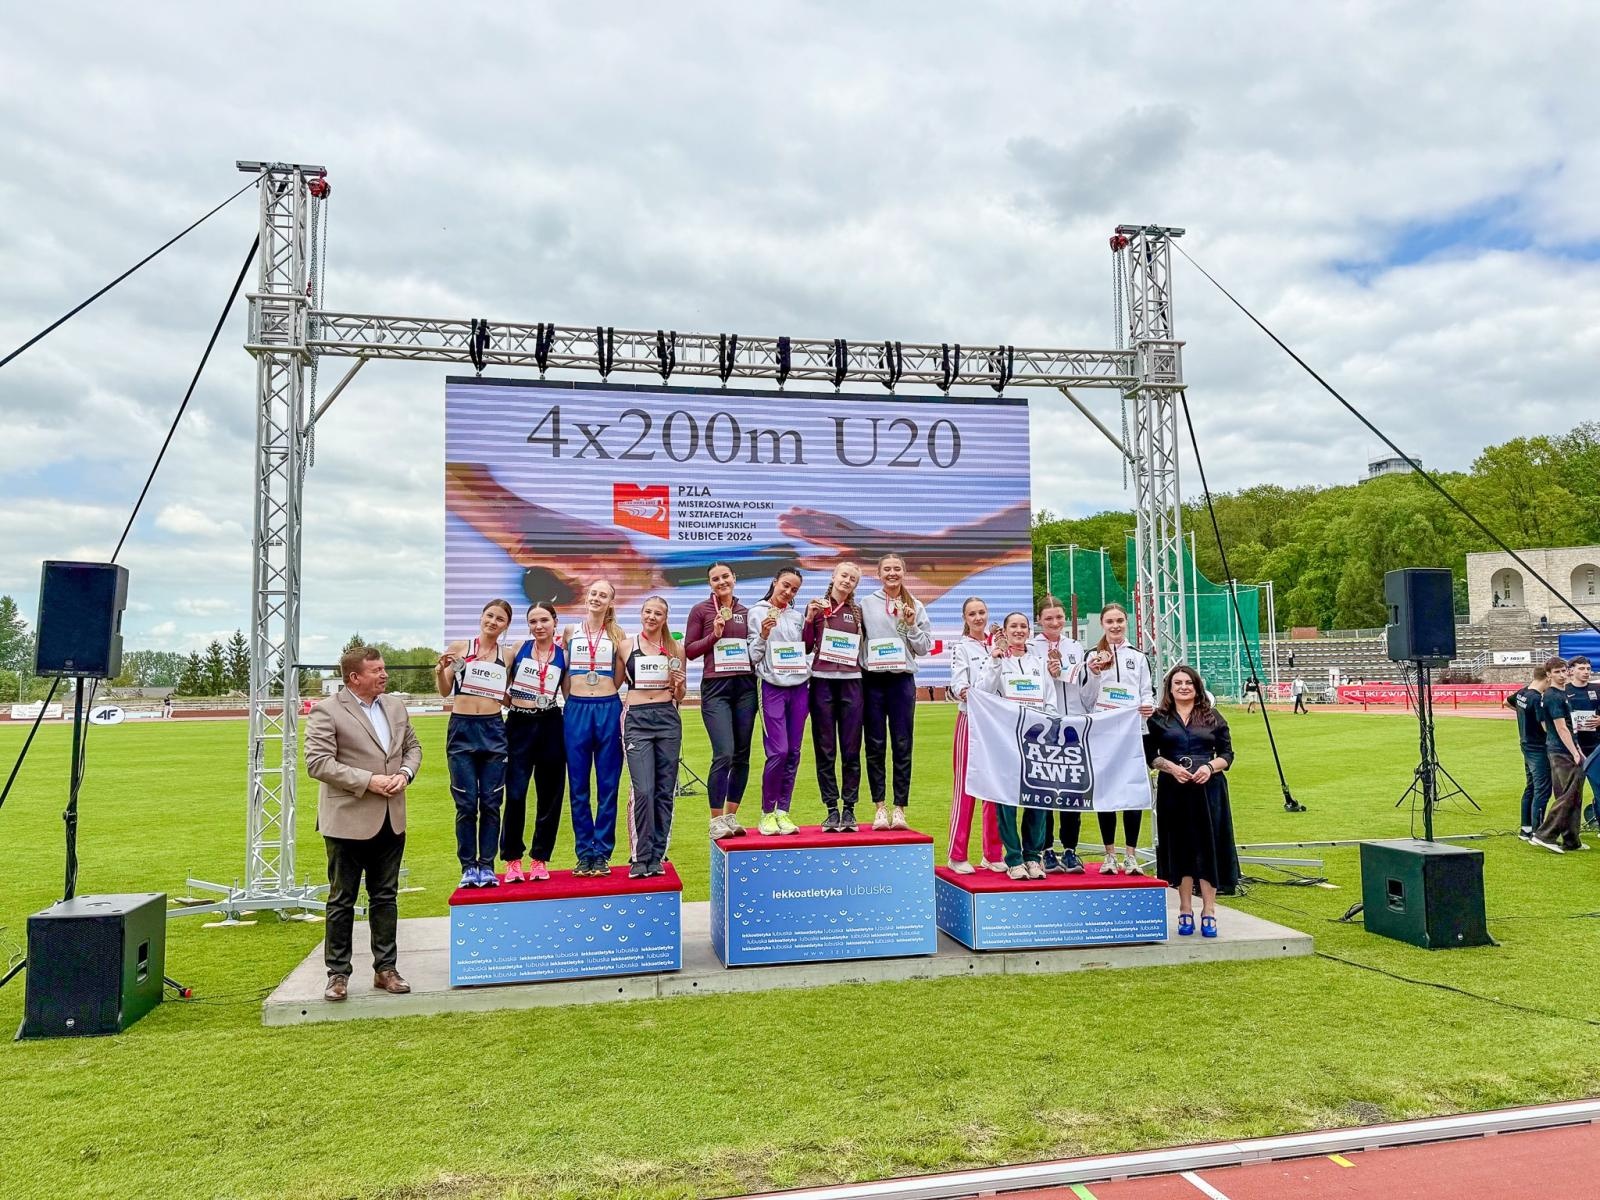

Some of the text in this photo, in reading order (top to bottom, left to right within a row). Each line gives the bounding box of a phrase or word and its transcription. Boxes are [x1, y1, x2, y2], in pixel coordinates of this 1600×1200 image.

[526, 405, 962, 469] 4x200m U20
[678, 485, 711, 497] PZLA
[677, 500, 774, 509] MISTRZOSTWA POLSKI
[677, 510, 744, 519] W SZTAFETACH
[678, 520, 757, 529] NIEOLIMPIJSKICH
[677, 531, 753, 541] SŁUBICE 2026
[96, 709, 118, 720] 4F
[1026, 742, 1082, 765] AZS
[1027, 761, 1085, 783] AWF
[1022, 793, 1091, 807] WROCŁAW
[772, 883, 893, 899] lekkoatletyka lubuska
